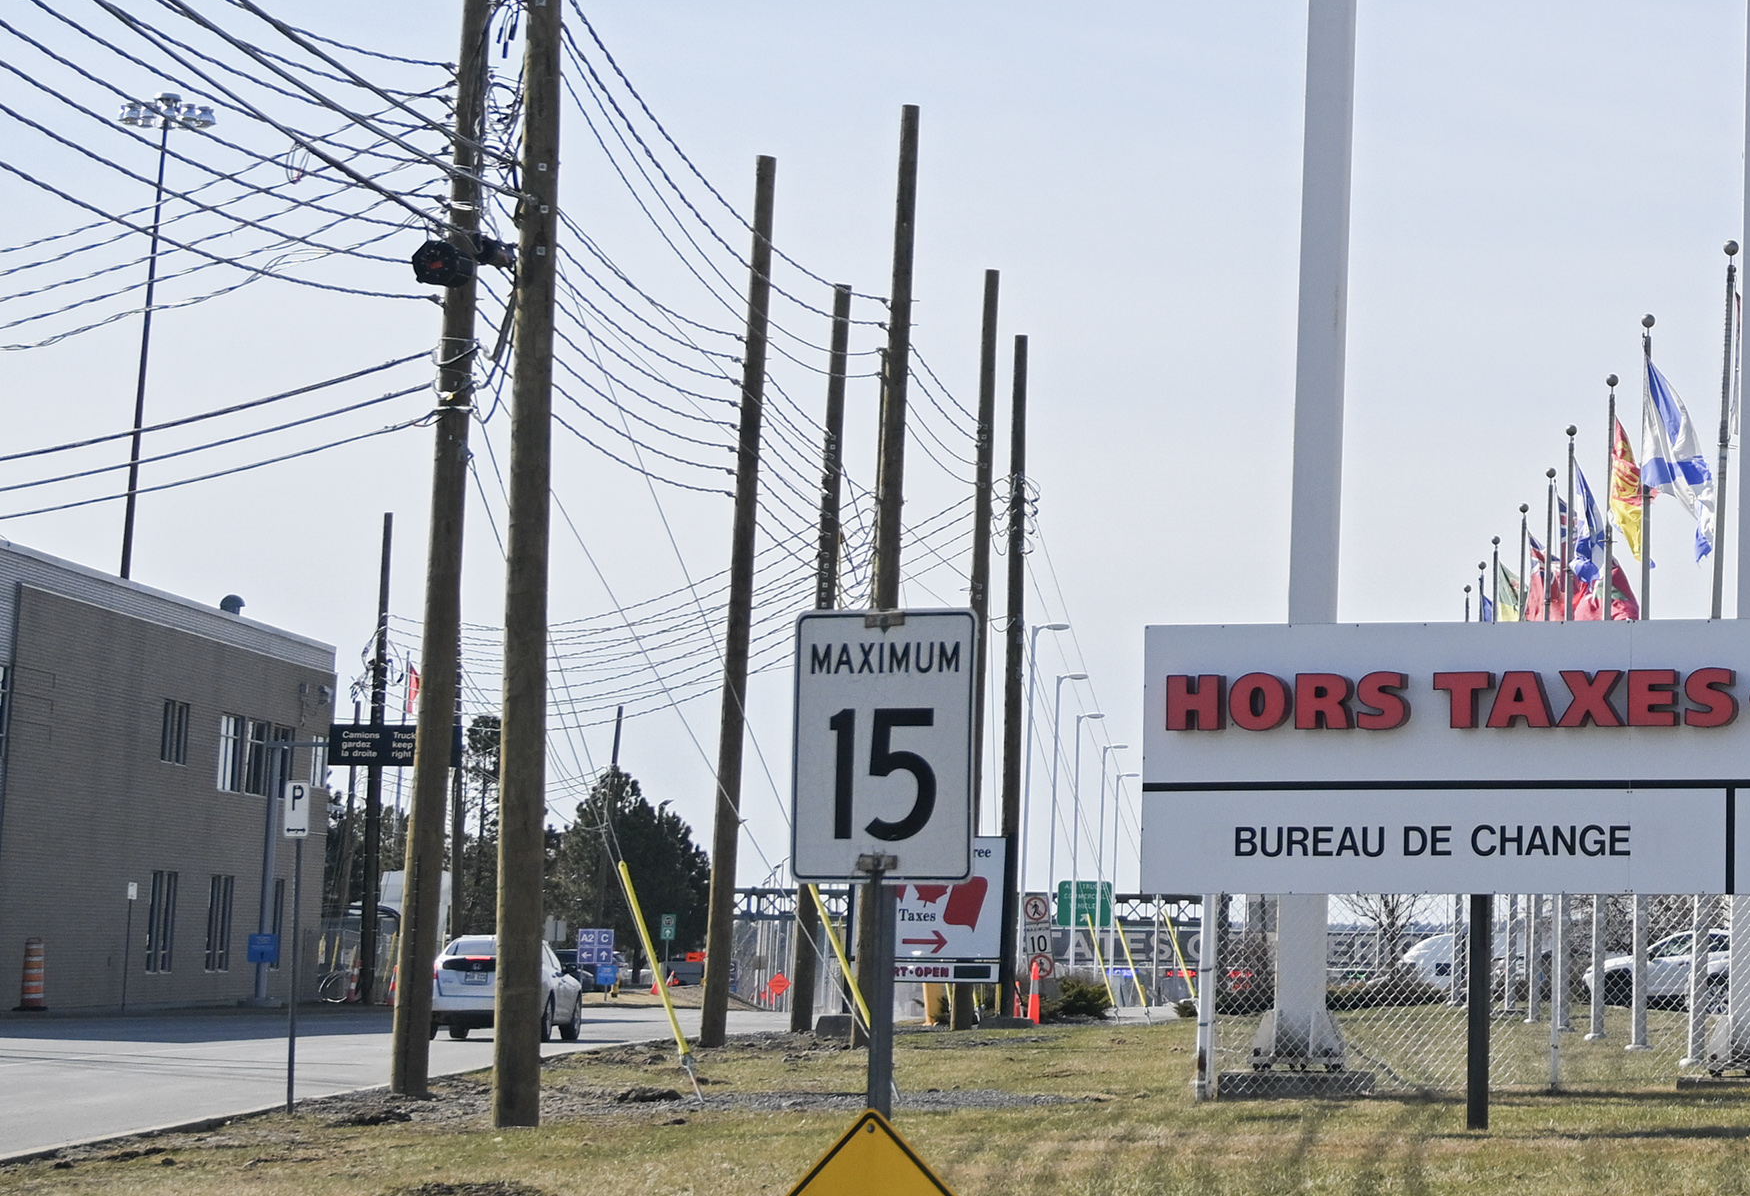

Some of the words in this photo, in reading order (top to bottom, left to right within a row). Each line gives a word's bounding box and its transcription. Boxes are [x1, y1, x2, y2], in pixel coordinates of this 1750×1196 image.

[810, 640, 961, 675] MAXIMUM
[1166, 671, 1410, 732] HORS
[1434, 667, 1739, 731] TAXES
[342, 730, 380, 739] Camions
[341, 740, 371, 749] gardez
[391, 740, 413, 750] keep
[341, 749, 349, 757] la
[352, 749, 378, 758] droite
[391, 749, 412, 759] right
[828, 707, 938, 843] 15
[292, 784, 304, 811] P
[1234, 825, 1385, 858] BUREAU
[1403, 825, 1452, 857] DE
[1470, 824, 1632, 857] CHANGE
[973, 847, 991, 858] ree
[898, 908, 936, 922] Taxes
[581, 934, 595, 943] A2
[600, 934, 609, 943] C
[1030, 934, 1047, 953] 10
